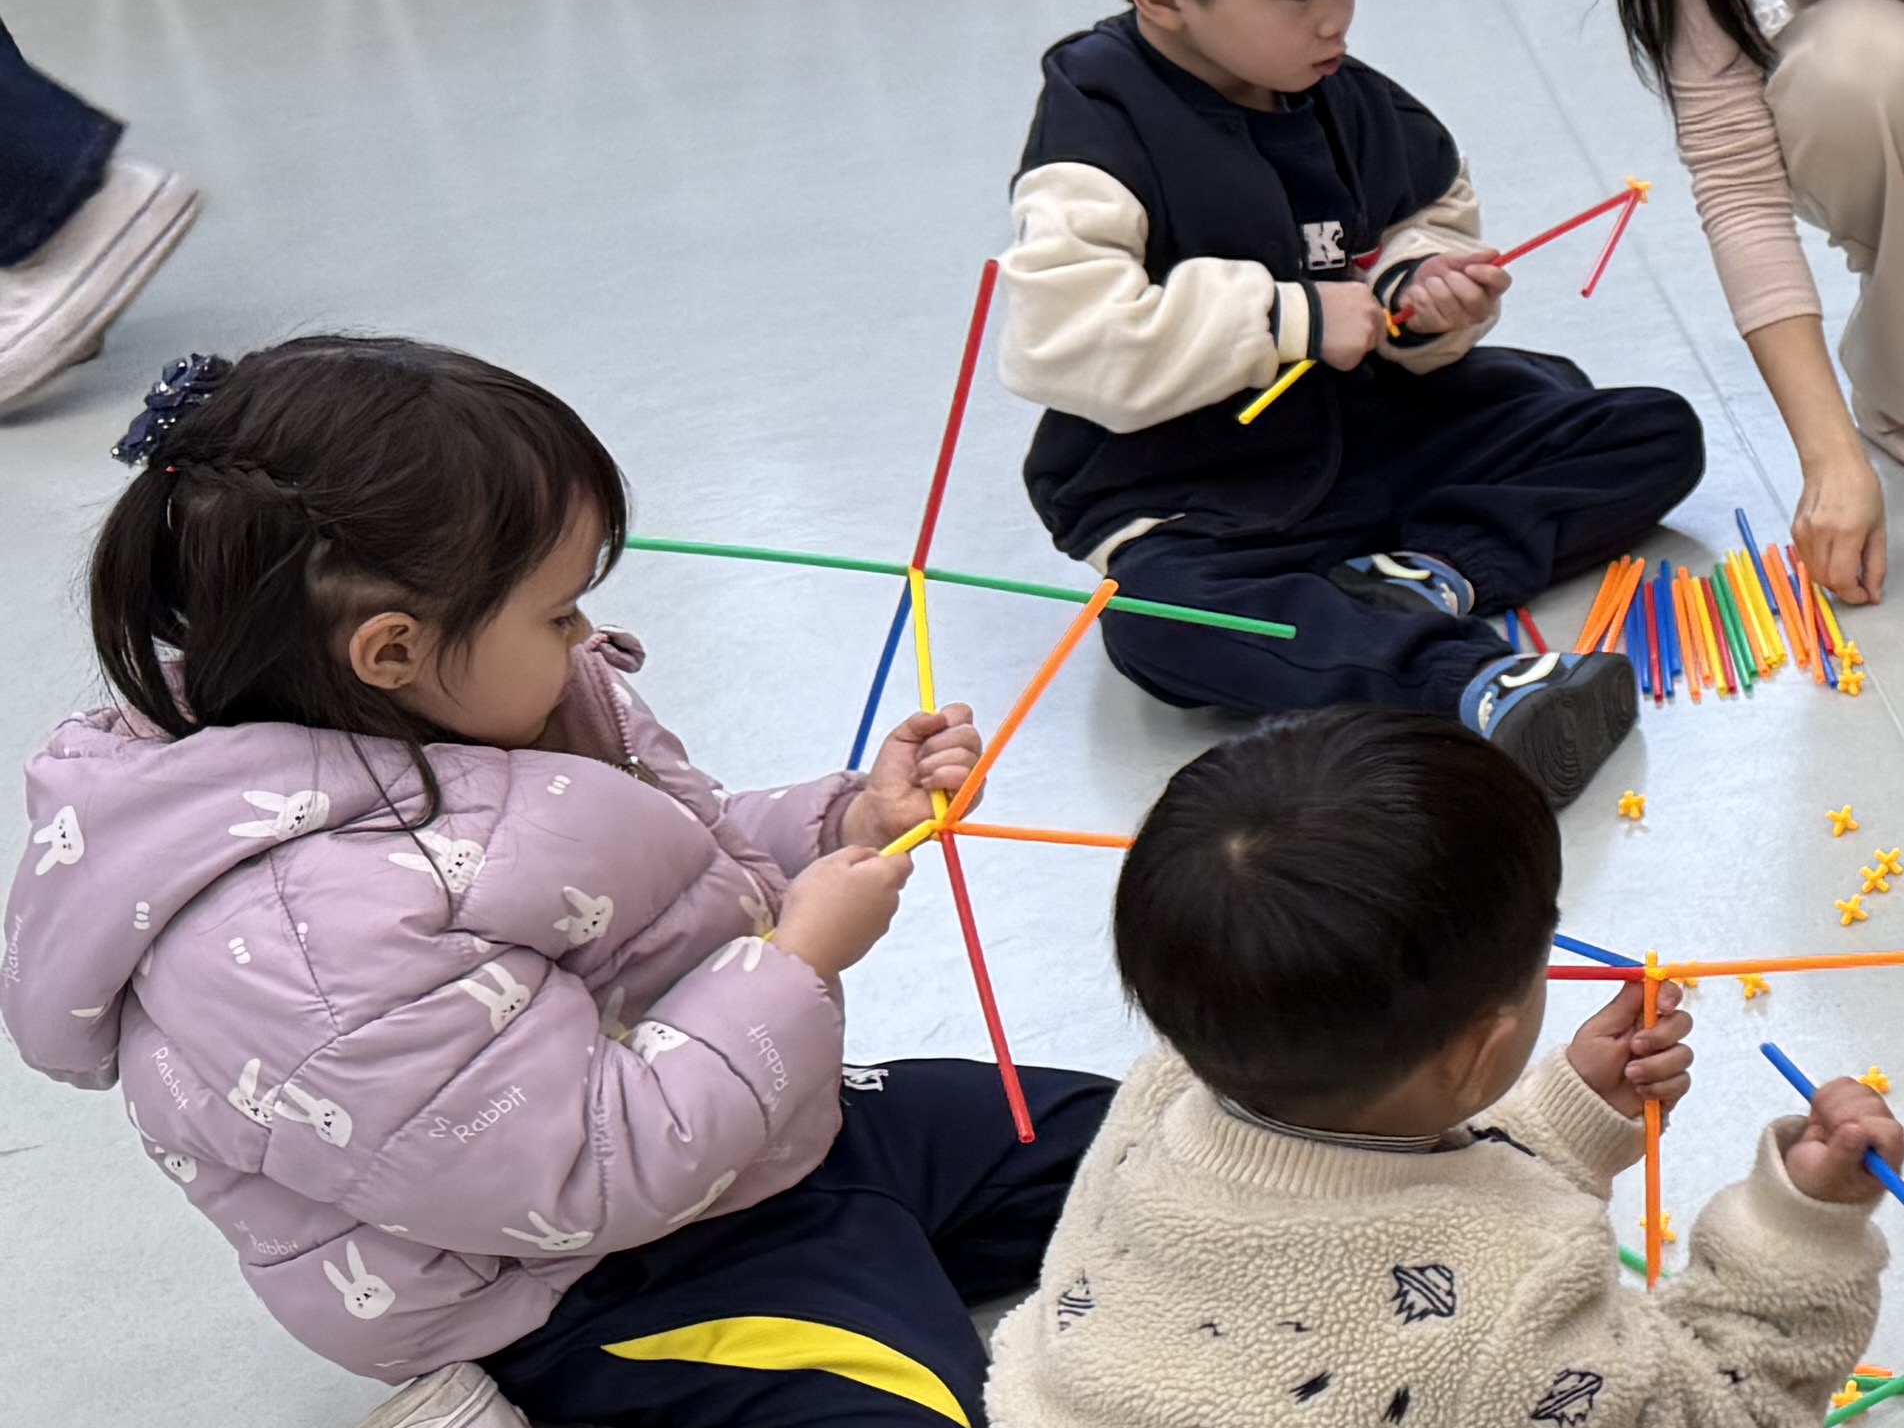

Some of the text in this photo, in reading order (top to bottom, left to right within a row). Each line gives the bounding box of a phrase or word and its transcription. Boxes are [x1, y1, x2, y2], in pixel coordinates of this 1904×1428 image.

[1303, 221, 1346, 270] K
[151, 1044, 189, 1111] Rabbit
[747, 1024, 788, 1092] Rabbit
[452, 1084, 527, 1144] Rabbit
